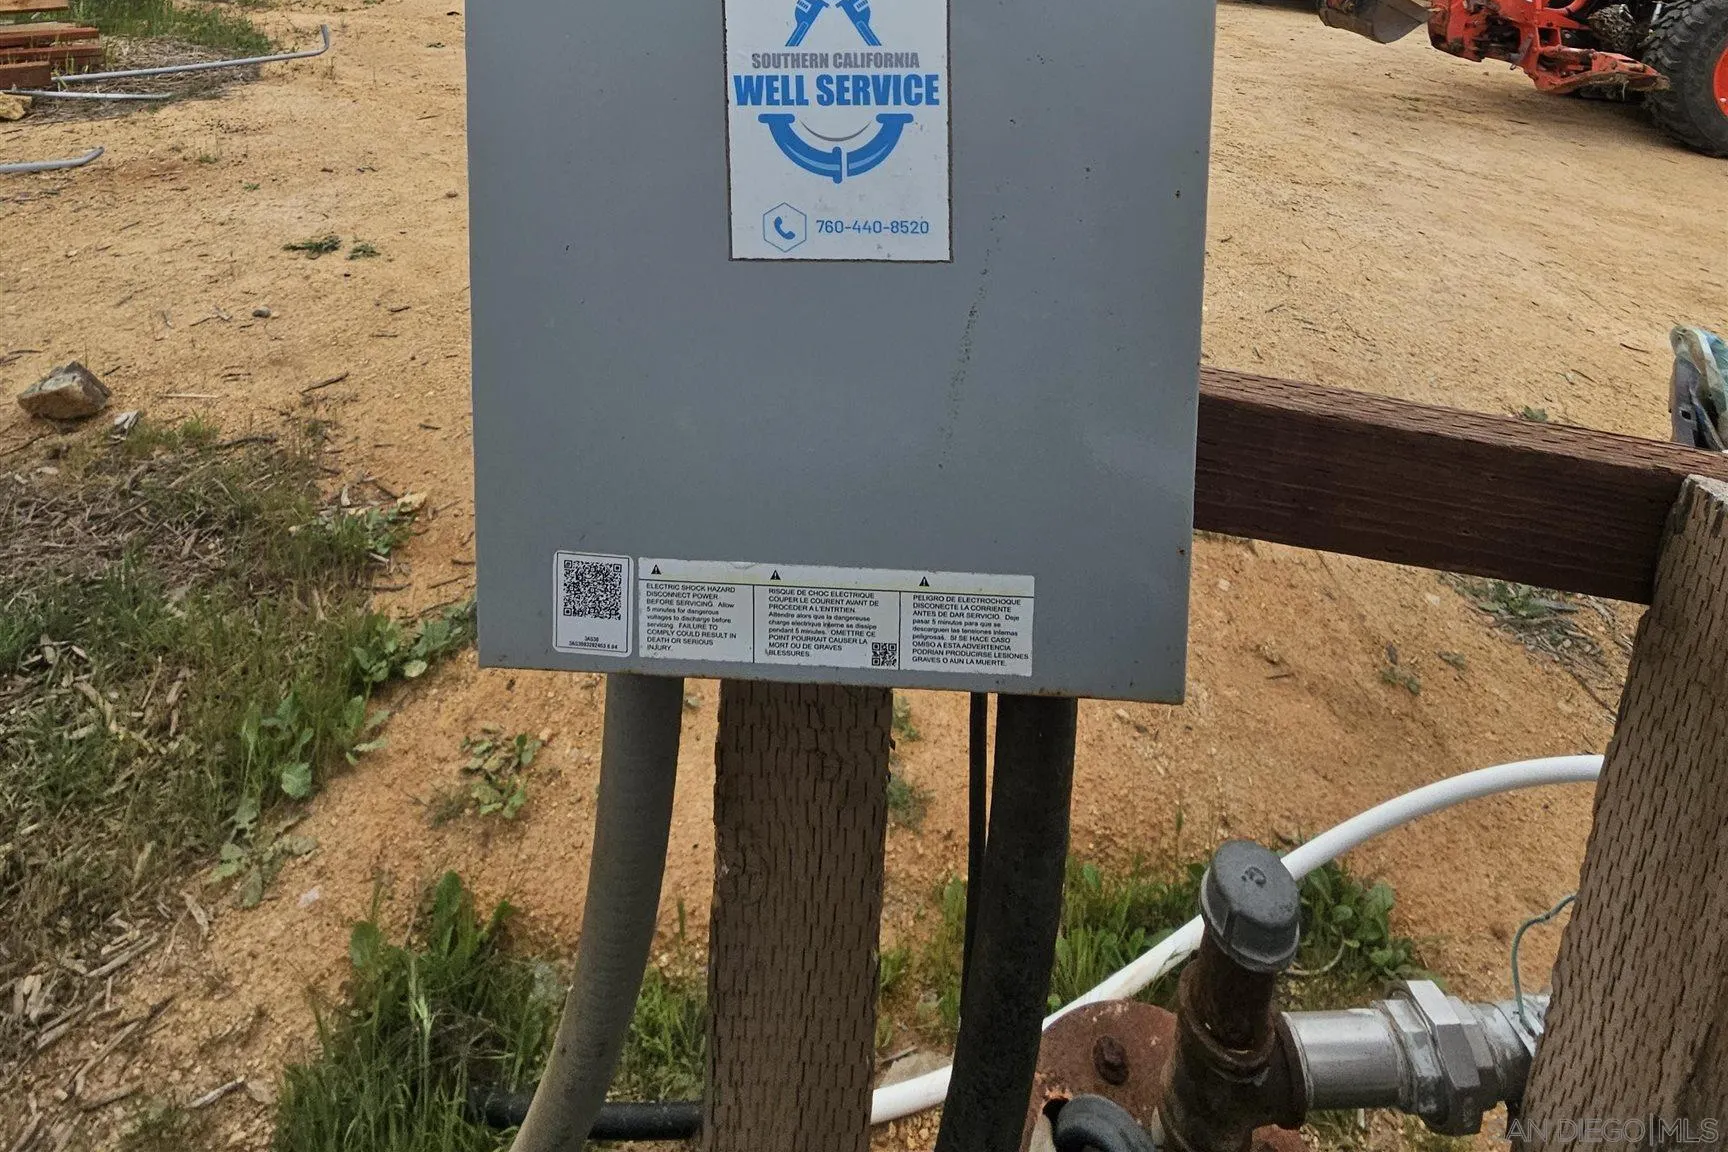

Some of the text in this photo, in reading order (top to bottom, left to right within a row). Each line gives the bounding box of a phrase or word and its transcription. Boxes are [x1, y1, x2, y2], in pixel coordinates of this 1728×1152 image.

[752, 52, 920, 69] SOUTHERN CALIFORNIA
[734, 74, 940, 106] WELL SERVICE
[816, 220, 929, 234] 760-440-8520
[958, 597, 1021, 605] ELECTROCHOQUE
[994, 652, 1029, 660] LESIONES
